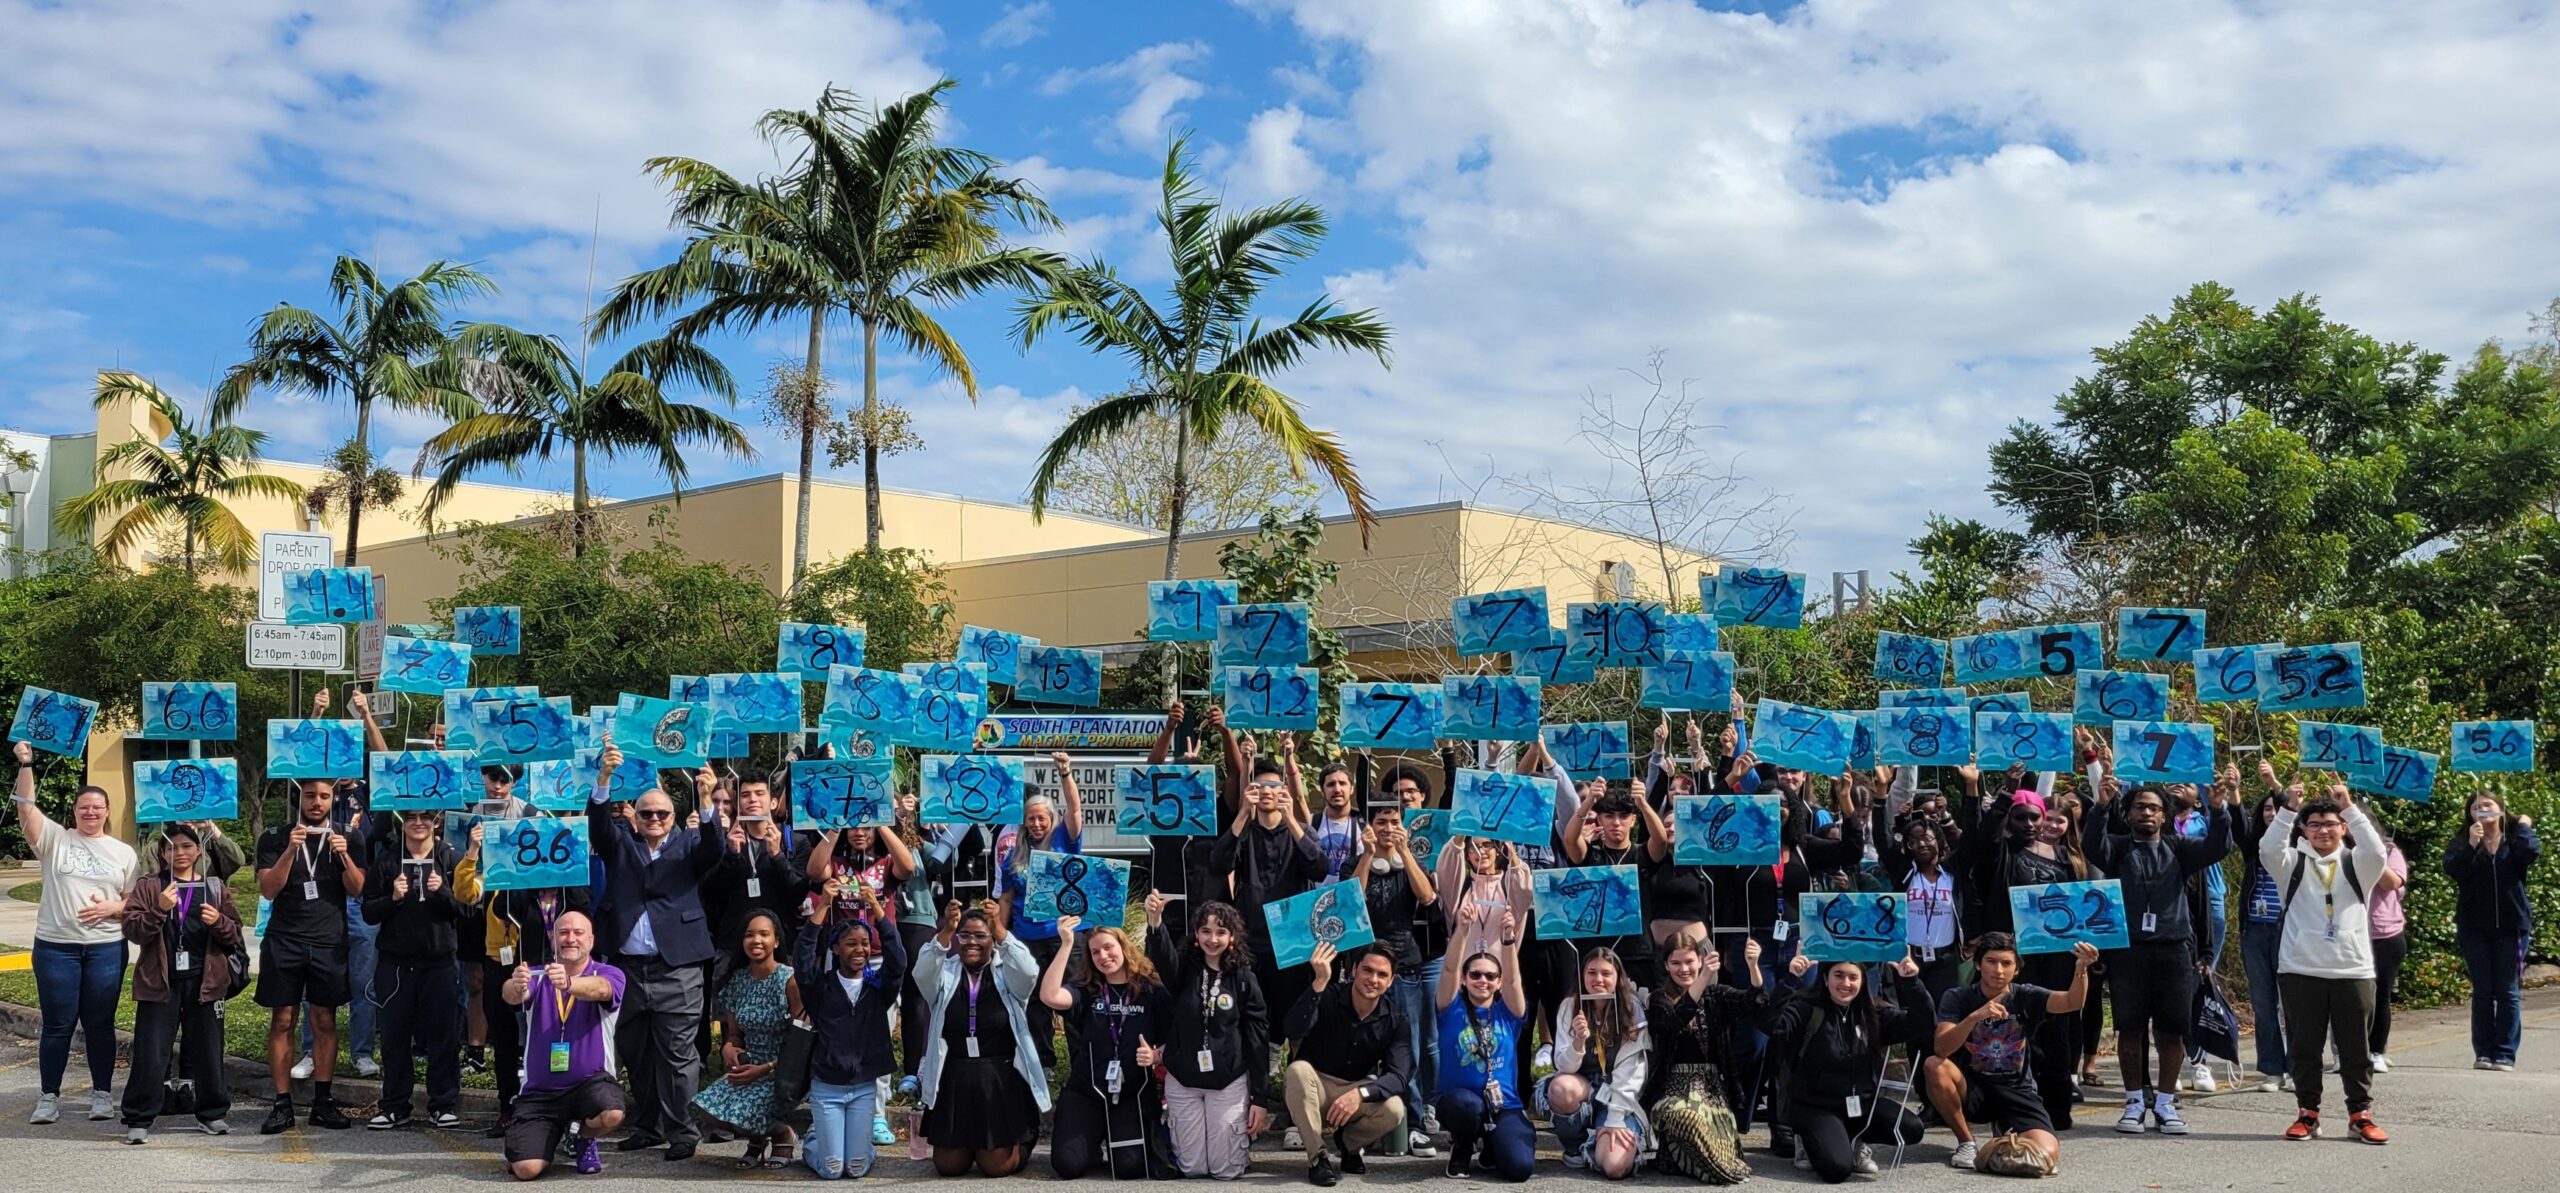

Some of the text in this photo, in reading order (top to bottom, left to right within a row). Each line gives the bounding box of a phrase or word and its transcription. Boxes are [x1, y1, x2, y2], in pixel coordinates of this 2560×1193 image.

[268, 561, 300, 573] DROP
[276, 543, 320, 558] PARENT
[306, 572, 368, 619] 4.4
[1177, 590, 1200, 631] 7
[1741, 571, 1788, 622] 7
[254, 629, 291, 641] 6:45am
[301, 630, 336, 642] 7:45am
[365, 625, 378, 638] FIRE
[1245, 610, 1280, 659] 7
[1481, 598, 1526, 647] 7
[1592, 605, 1649, 657] 10
[2144, 614, 2191, 658] 7
[254, 649, 292, 661] 2:10pm
[301, 650, 338, 662] 3:00pm
[364, 639, 380, 652] LANE
[399, 649, 454, 681] 7.6
[810, 630, 838, 670] 8
[1530, 645, 1567, 681] 7
[1969, 636, 1998, 673] 6
[2040, 632, 2075, 676] 5
[1042, 663, 1071, 692] 15
[1671, 660, 1693, 690] 7
[2220, 650, 2256, 694] 6
[2277, 650, 2355, 701] 5.2
[164, 689, 228, 732] 6.6
[377, 693, 391, 711] WAY
[742, 683, 765, 723] 8
[854, 675, 884, 720] 8
[1249, 673, 1309, 718] 9.2
[1373, 693, 1411, 740] 7
[1476, 684, 1498, 728] 4
[2099, 676, 2137, 719] 6
[507, 703, 539, 754] 5
[654, 707, 693, 753] 6
[927, 695, 950, 741] 9
[1008, 719, 1165, 734] SOUTH PLANTATION
[1789, 708, 1826, 750] 7
[1908, 714, 1941, 757] 8
[307, 728, 329, 772] 9
[1019, 734, 1084, 748] MAGNET
[1564, 727, 1612, 772] 12
[2012, 722, 2038, 760] 8
[2144, 732, 2177, 772] 7
[2316, 729, 2375, 764] 8.1
[2471, 729, 2520, 756] 5.6
[172, 765, 206, 812] 9
[393, 764, 443, 798] 12
[957, 767, 989, 813] 8
[1035, 768, 1115, 784] WECOME
[2384, 753, 2412, 789] 7
[820, 776, 867, 818] 7
[1150, 772, 1183, 830] 5
[1482, 779, 1523, 831] 7
[516, 829, 572, 866] 8.6
[1708, 803, 1740, 852] 6
[1056, 857, 1088, 916] 8
[1558, 880, 1608, 934] 7
[1310, 888, 1345, 941] 6
[1823, 895, 1896, 936] 6.8
[2038, 888, 2116, 936] 5.2
